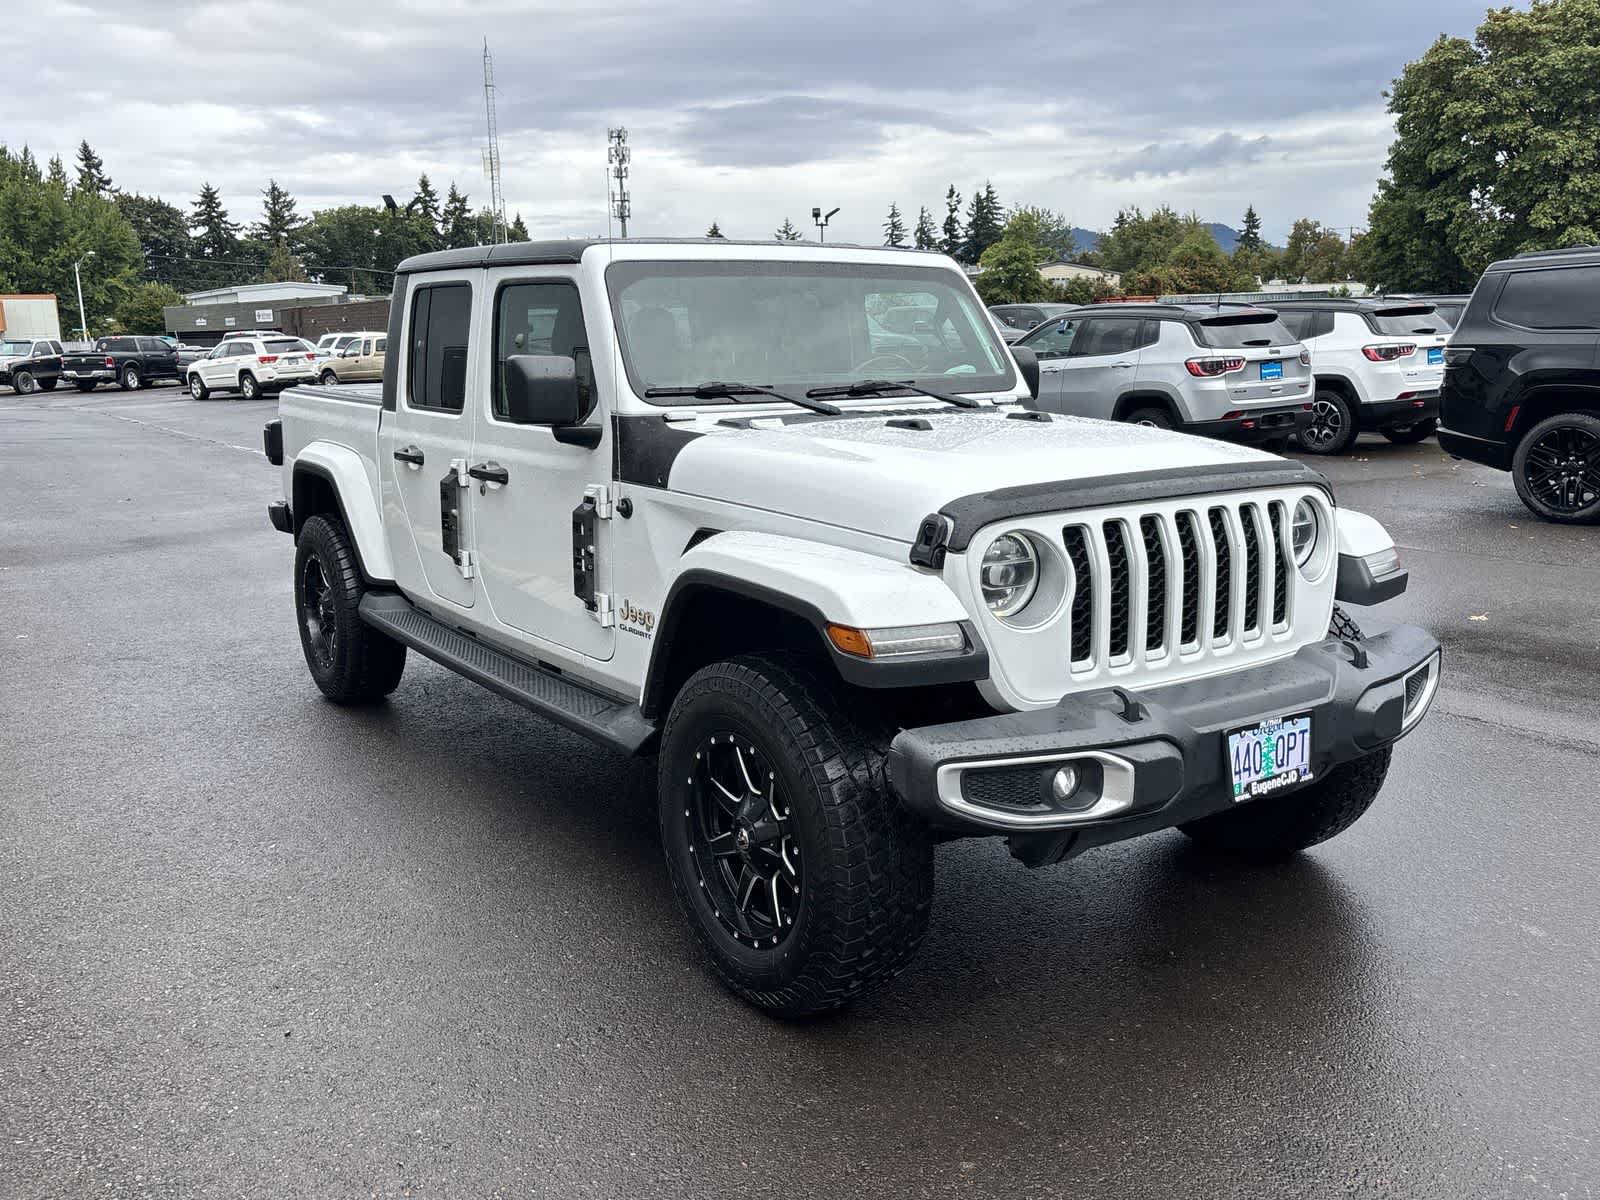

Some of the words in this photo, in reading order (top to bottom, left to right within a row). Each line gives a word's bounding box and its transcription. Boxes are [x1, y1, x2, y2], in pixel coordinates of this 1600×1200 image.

[619, 599, 655, 632] Jeep
[1234, 741, 1262, 780] 440
[1275, 728, 1308, 768] QPT
